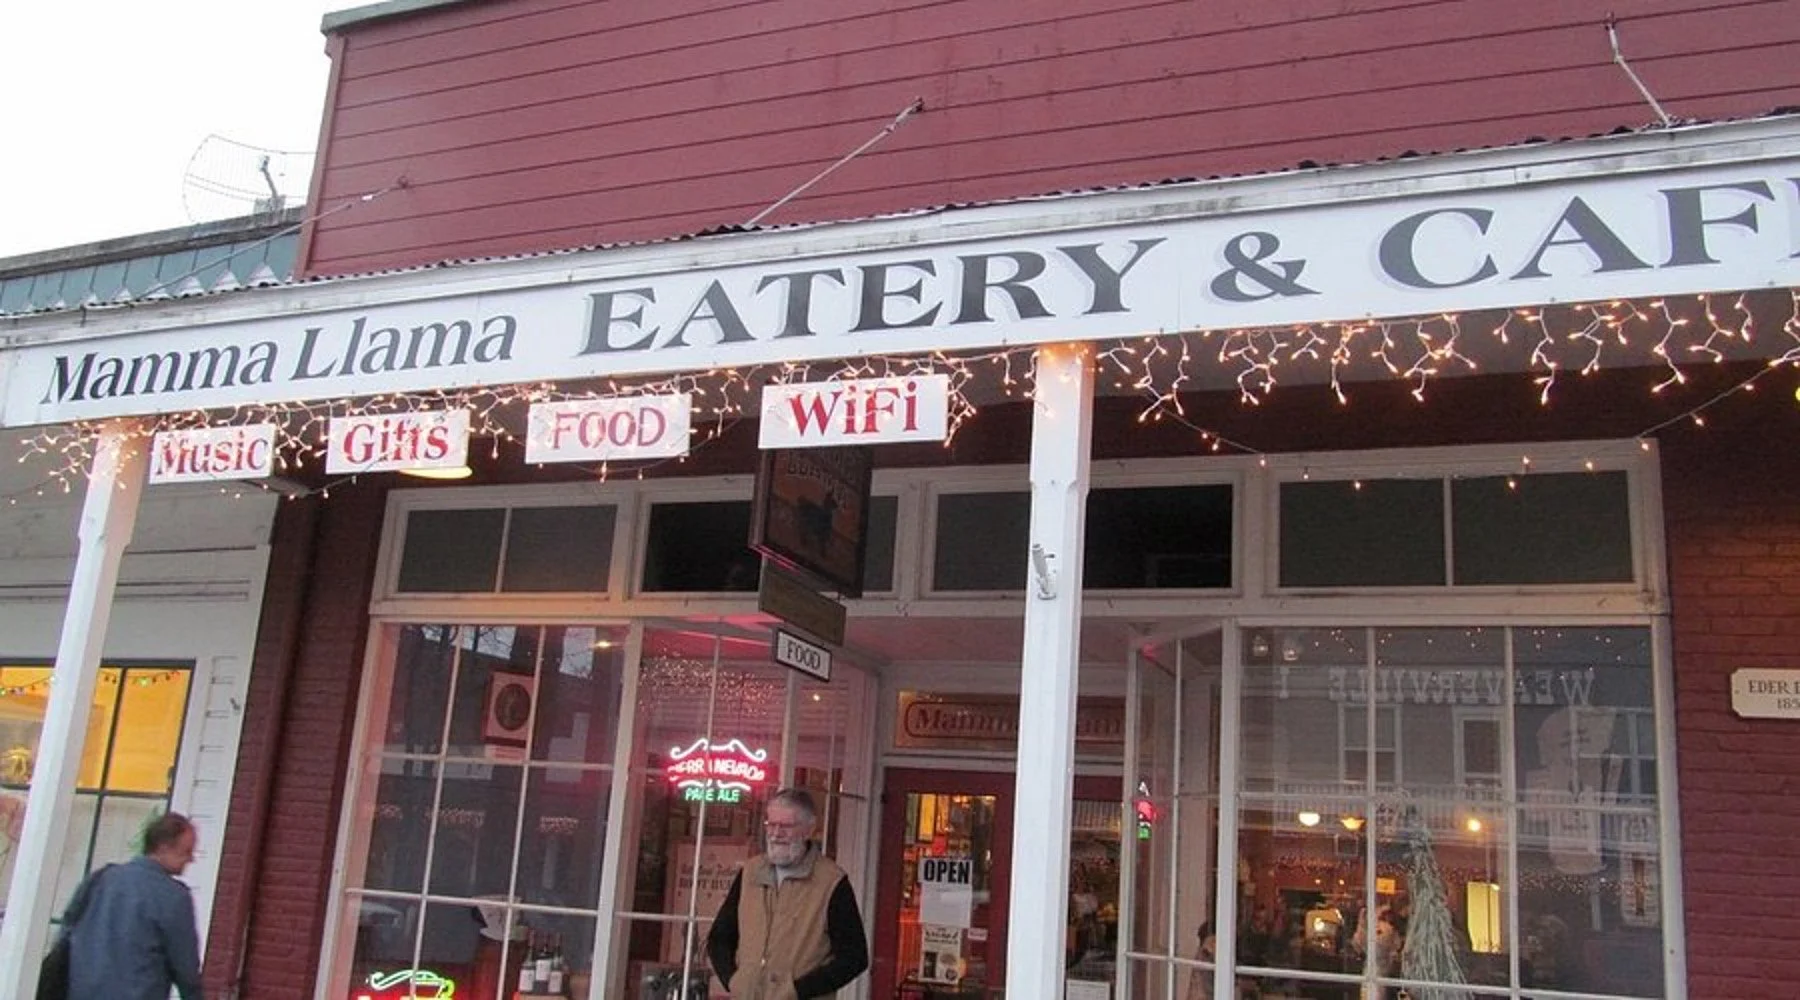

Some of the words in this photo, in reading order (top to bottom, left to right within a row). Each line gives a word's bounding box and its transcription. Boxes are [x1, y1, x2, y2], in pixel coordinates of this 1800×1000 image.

[39, 340, 278, 405] Mamma
[288, 314, 518, 381] Llama
[575, 236, 1169, 357] EATERY
[1208, 231, 1322, 301] &
[1377, 177, 1800, 290] CAF
[552, 406, 667, 450] FOOD
[787, 382, 921, 438] WiFi
[155, 430, 269, 476] Music
[343, 417, 450, 464] Gifts
[786, 640, 821, 670] FOOD
[1748, 679, 1791, 694] EDER
[915, 708, 1016, 732] Mamm
[685, 787, 714, 801] PAE
[717, 788, 741, 803] ALE
[923, 859, 970, 885] OPEN
